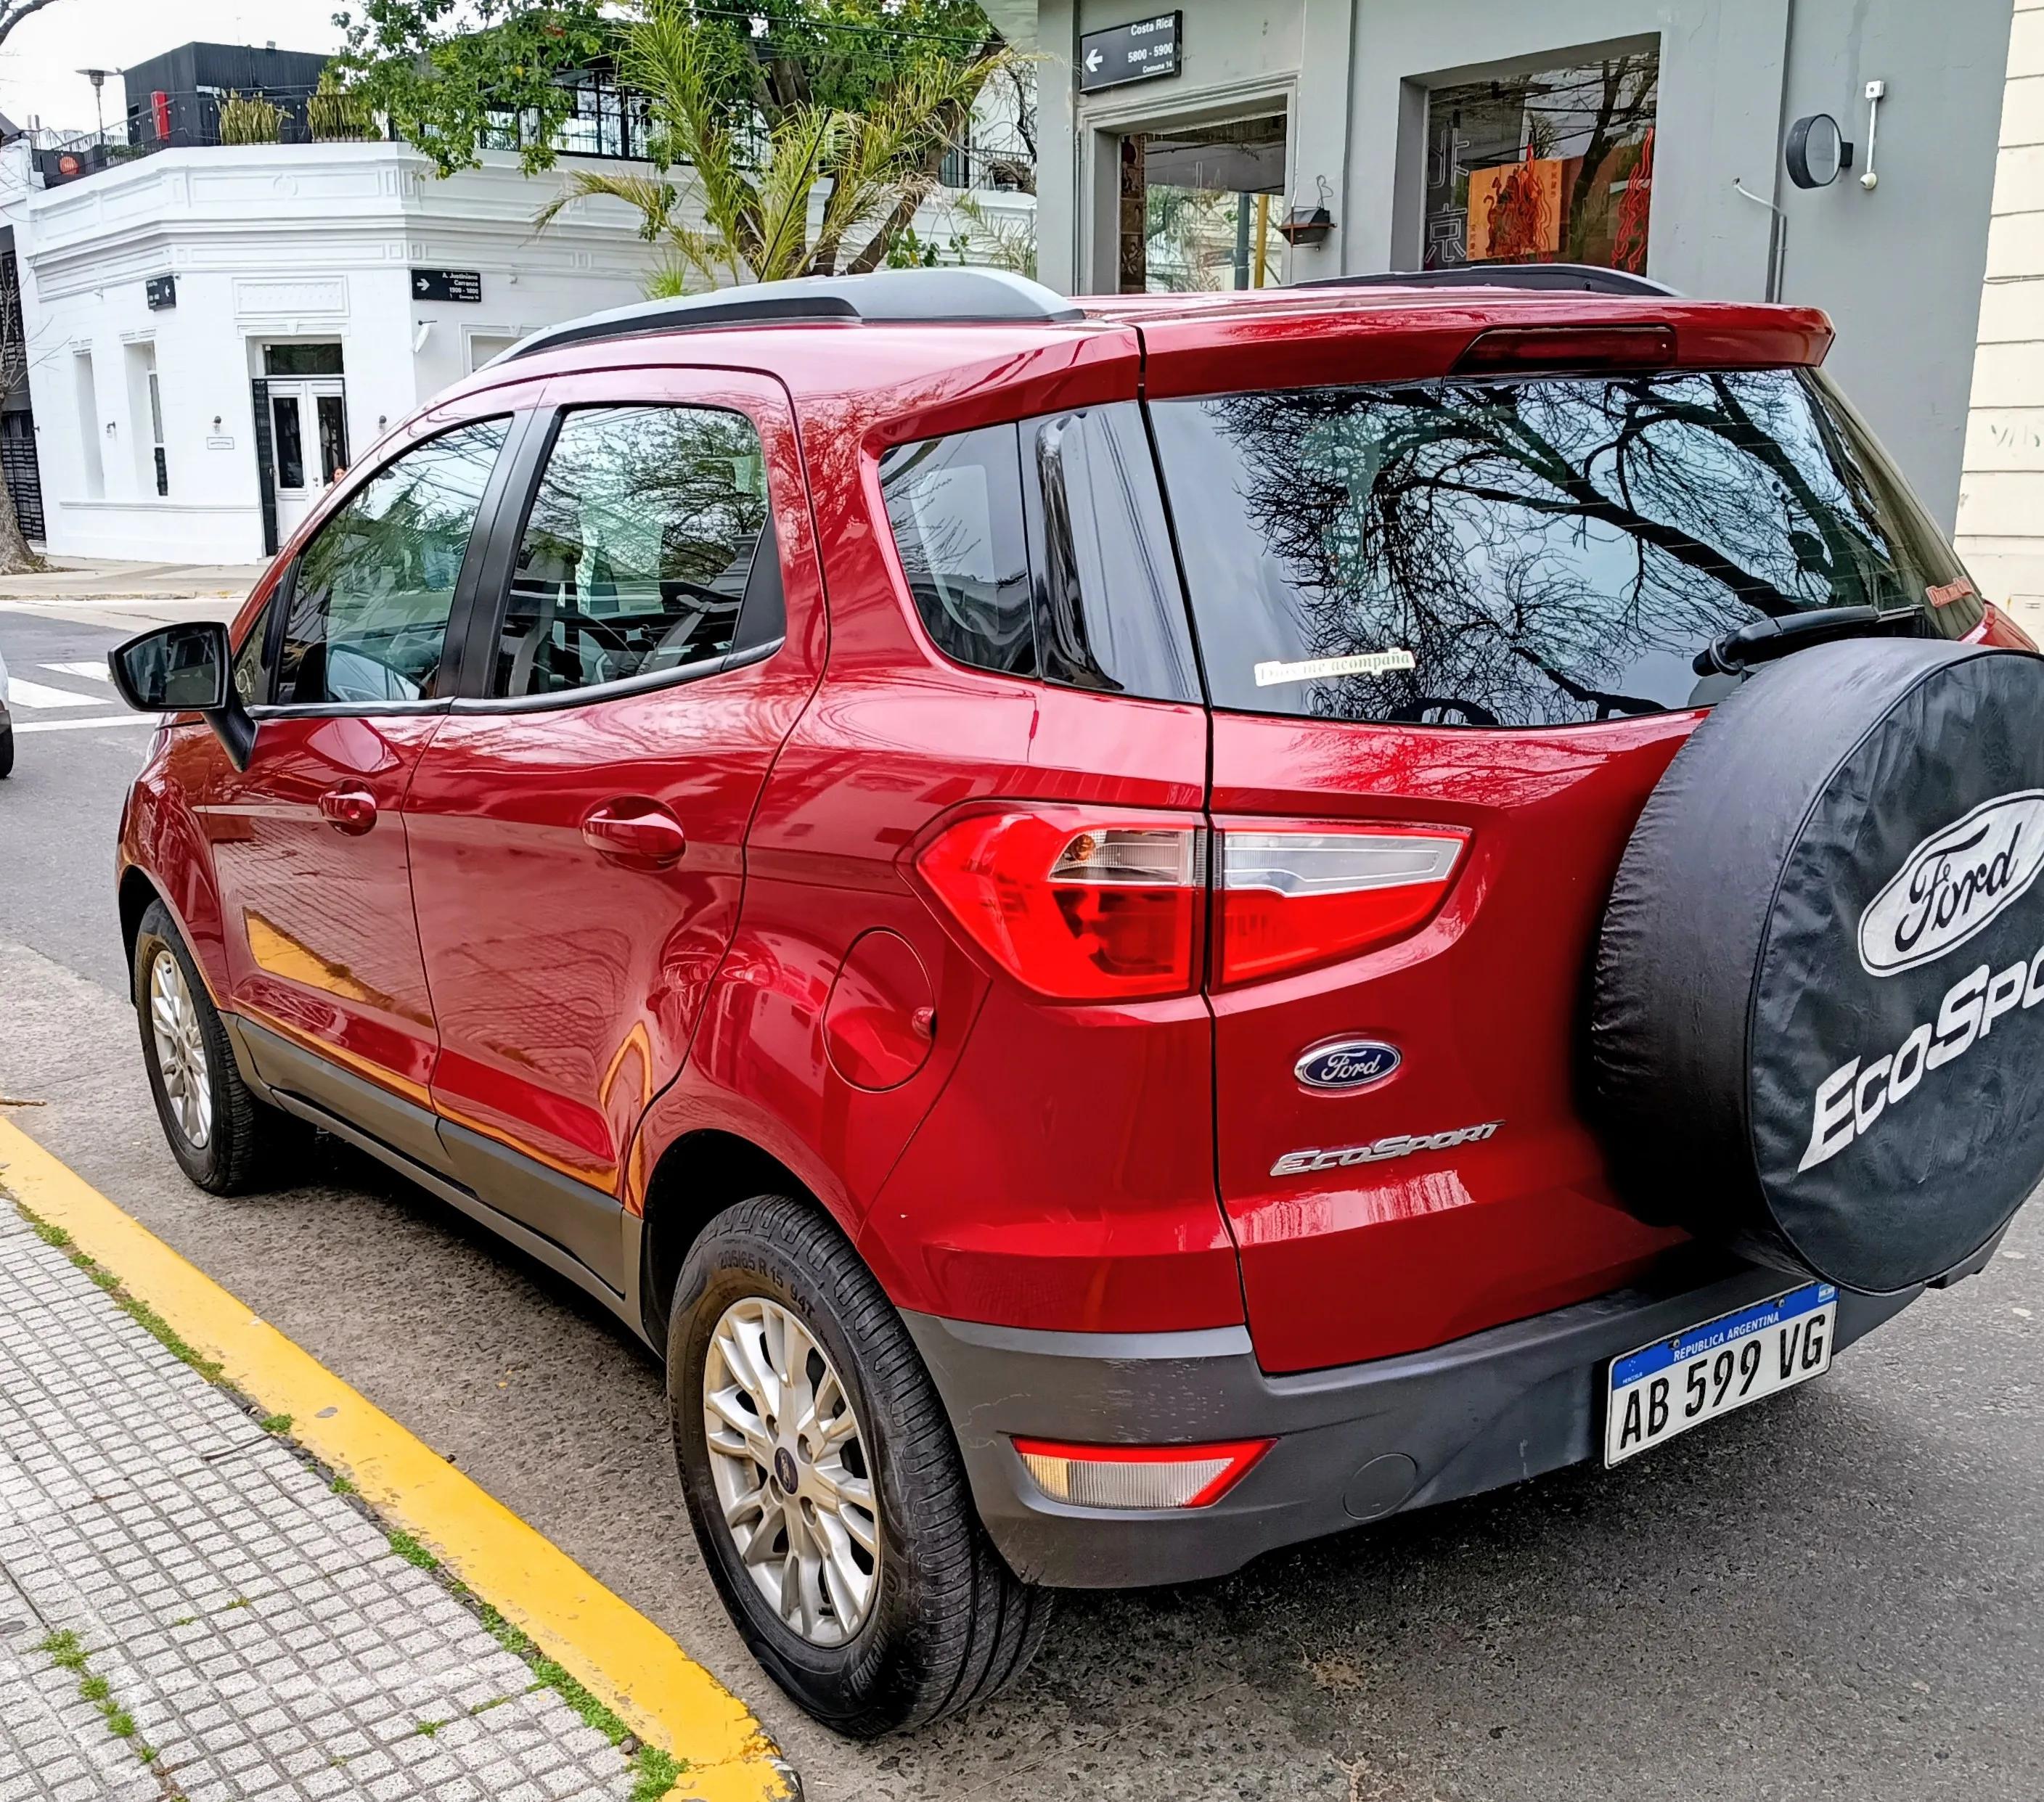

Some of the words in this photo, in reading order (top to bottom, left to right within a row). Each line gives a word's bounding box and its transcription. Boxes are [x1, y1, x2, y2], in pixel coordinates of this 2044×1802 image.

[1131, 22, 1154, 36] Costa
[1156, 18, 1173, 30] Rica
[1128, 49, 1147, 62] 5800
[1153, 43, 1173, 57] 5900
[1142, 62, 1164, 73] Comuna
[1331, 651, 1410, 671] acompaña
[1894, 821, 2023, 953] Ford
[1321, 1051, 1382, 1081] Ford
[1270, 1119, 1506, 1176] EcoSport
[759, 1257, 768, 1277] R
[770, 1266, 784, 1288] 15
[790, 1283, 815, 1319] 94T
[1673, 1332, 1724, 1362] REPUBLICA
[1727, 1311, 1780, 1340] ARGENTINA
[1619, 1377, 1669, 1450] AB
[1685, 1340, 1762, 1417] 599
[1780, 1314, 1826, 1380] VG
